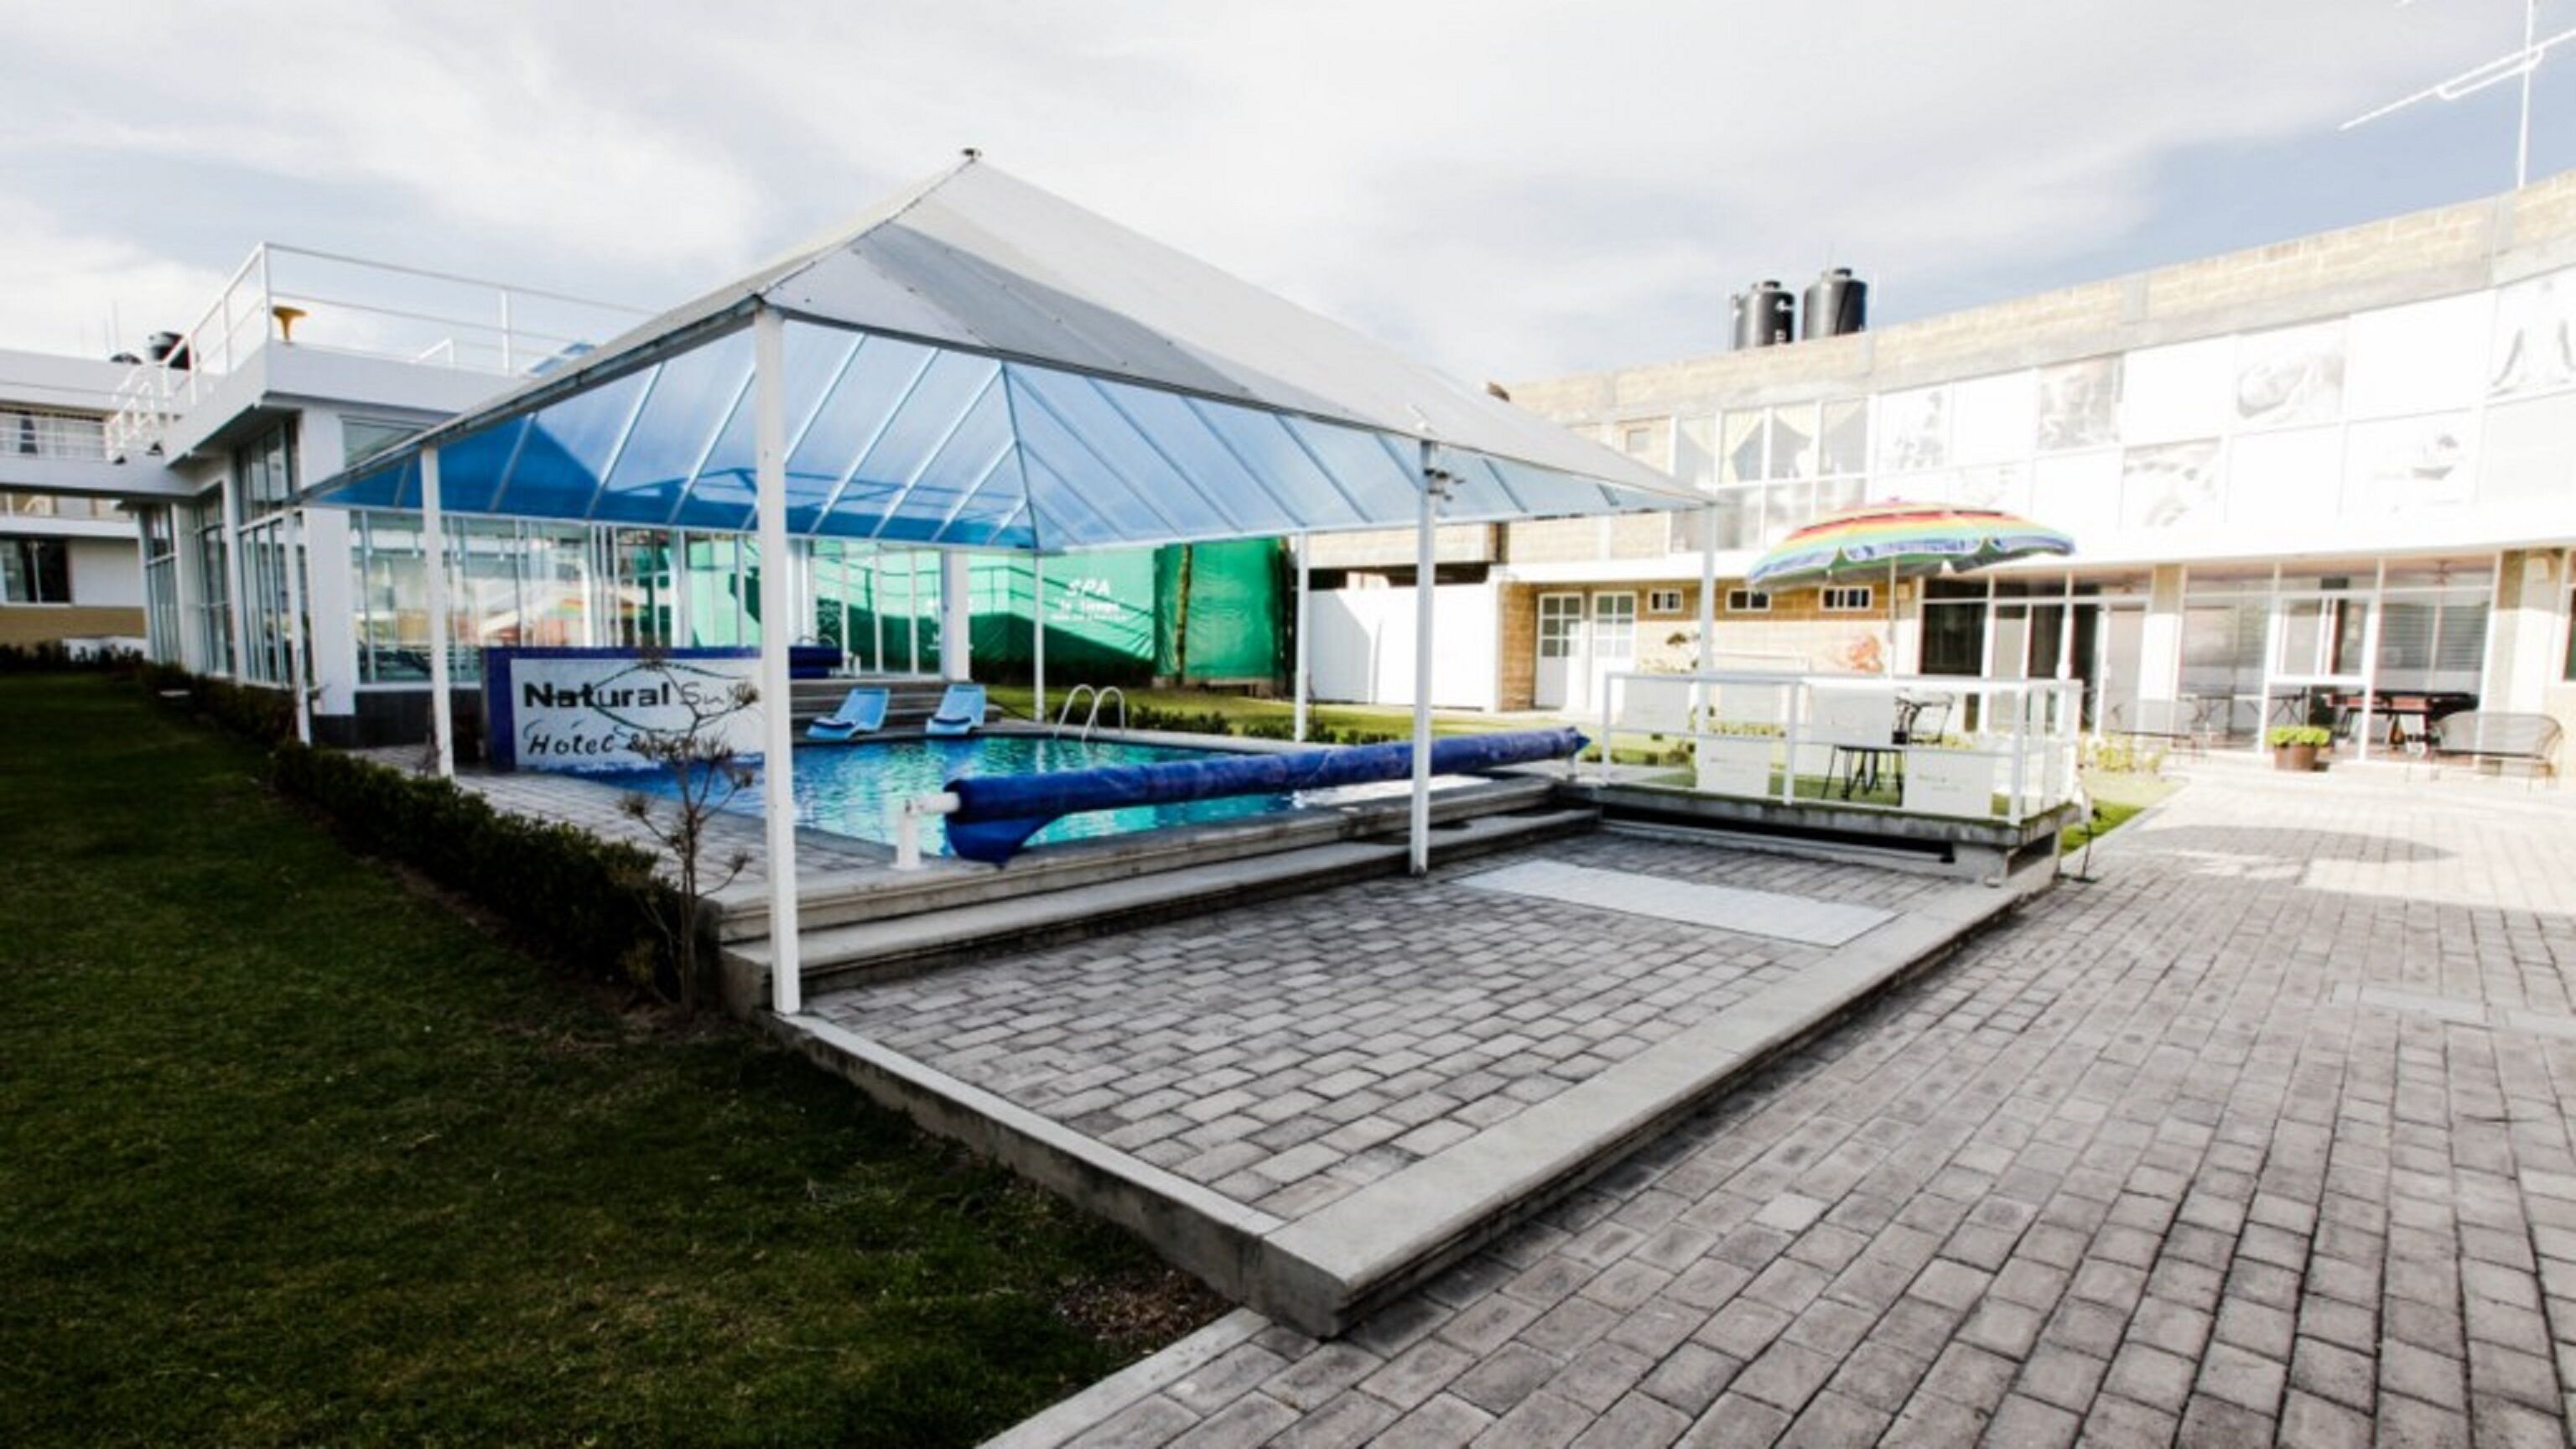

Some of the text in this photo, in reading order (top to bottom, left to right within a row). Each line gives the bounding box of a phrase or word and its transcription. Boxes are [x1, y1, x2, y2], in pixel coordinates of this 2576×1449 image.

[1065, 578, 1111, 597] SPA
[523, 682, 669, 707] Natural
[527, 733, 615, 755] Hotel
